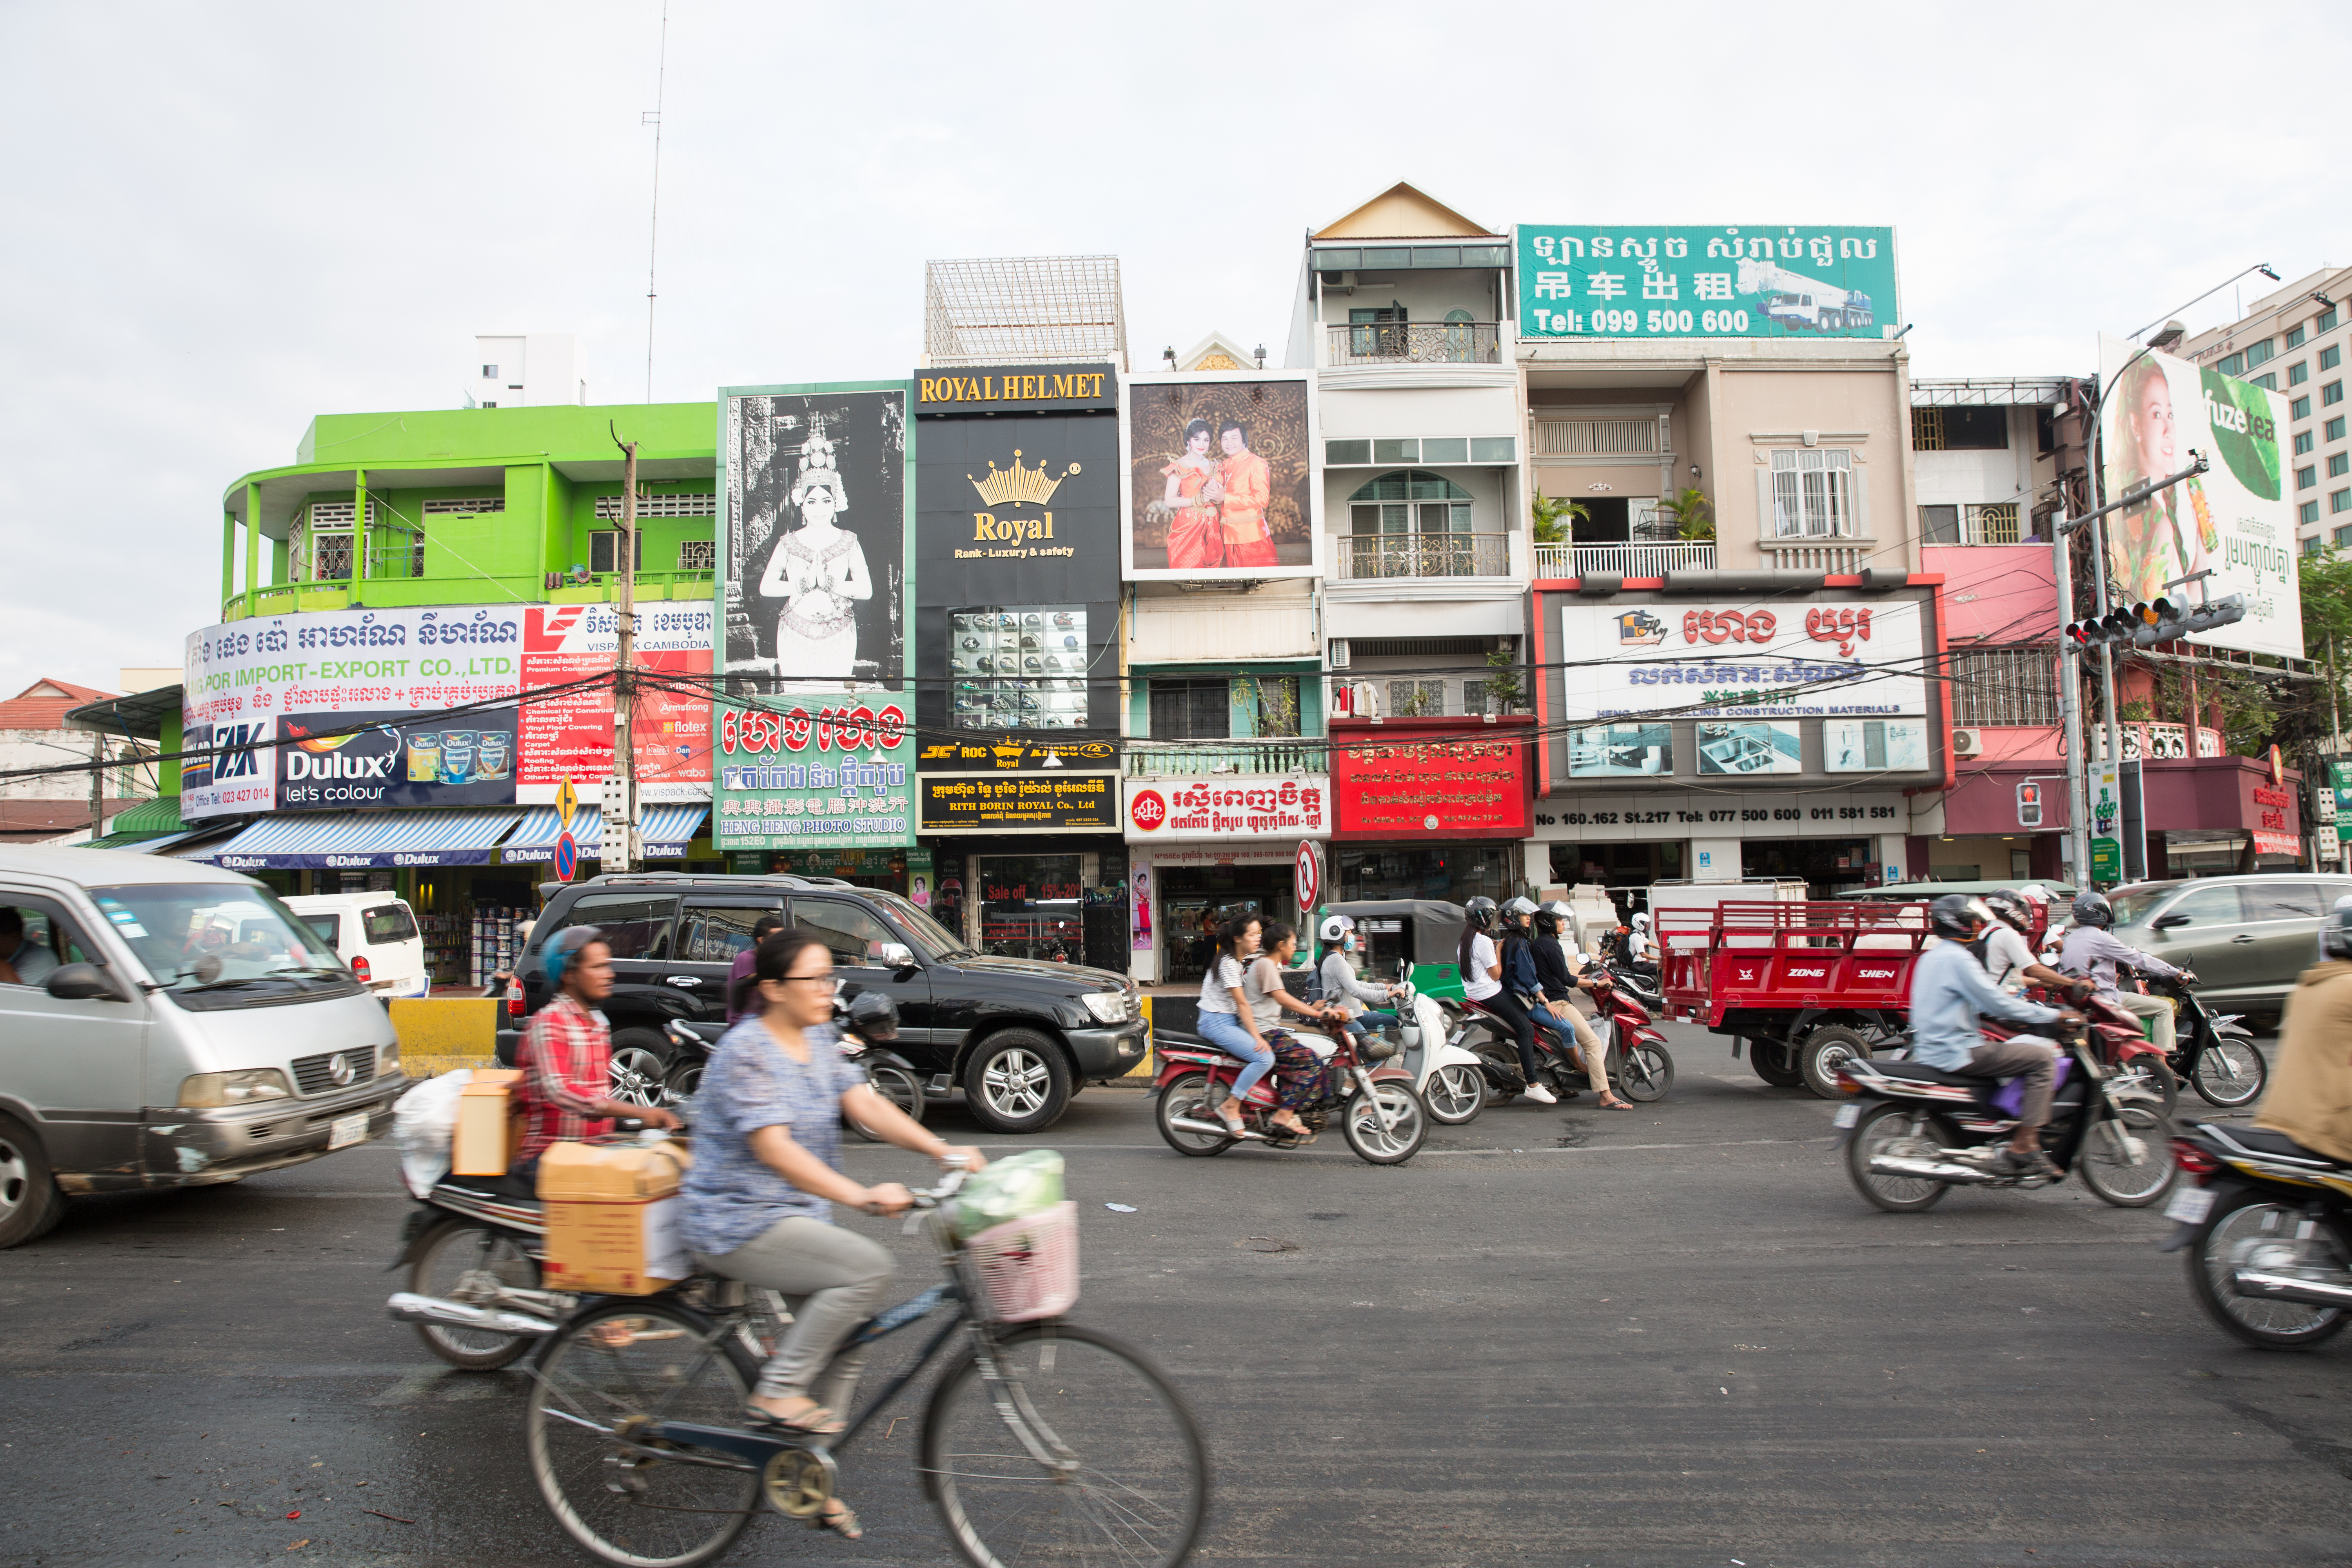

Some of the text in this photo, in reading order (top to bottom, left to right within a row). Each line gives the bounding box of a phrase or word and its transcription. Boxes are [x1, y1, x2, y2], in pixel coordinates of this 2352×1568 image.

[1535, 271, 1735, 301] 吊车出租
[1534, 309, 1748, 332] Tel: 099 500 600
[920, 373, 1105, 402] ROYAL HELMET
[973, 512, 1054, 547] Royal
[1029, 547, 1074, 557] & safety
[588, 640, 710, 651] VISPAK CAMBODIA
[205, 672, 230, 692] POR
[661, 704, 708, 713] Armstrong
[1597, 709, 1630, 718] HENG
[1726, 706, 1824, 715] CONSTRUCTION
[1829, 704, 1901, 714] MATERIALS
[675, 721, 706, 732] flotex
[962, 747, 987, 757] ROC
[287, 752, 386, 780] Dulux
[996, 759, 1018, 768] Royal
[678, 768, 705, 777] wabo
[196, 788, 269, 807] Office Tel: 023 427 014
[325, 787, 385, 800] colour
[980, 802, 1014, 810] BORIN
[1018, 802, 1053, 810] ROYAL
[1057, 802, 1074, 810] Co.,
[1078, 801, 1095, 809] Ltd
[1535, 814, 1555, 825] No
[1677, 811, 1703, 822] Tel:
[1709, 810, 1735, 822] 077
[1741, 809, 1768, 821] 500
[1774, 808, 1801, 821] 600
[1811, 808, 1834, 820] 011
[1839, 807, 1864, 819] 581
[1871, 806, 1896, 818] 581
[720, 817, 906, 835] HENG HENG PHOTO STUDIO
[517, 850, 552, 860] Dulux
[581, 847, 601, 858] Dul
[646, 846, 682, 856] Dulux
[232, 857, 267, 867] Dulux
[336, 856, 372, 866] Dulux
[404, 855, 439, 864] Dulux
[988, 885, 1026, 900] Sale off
[1787, 969, 1895, 978] ZONG SHEN
